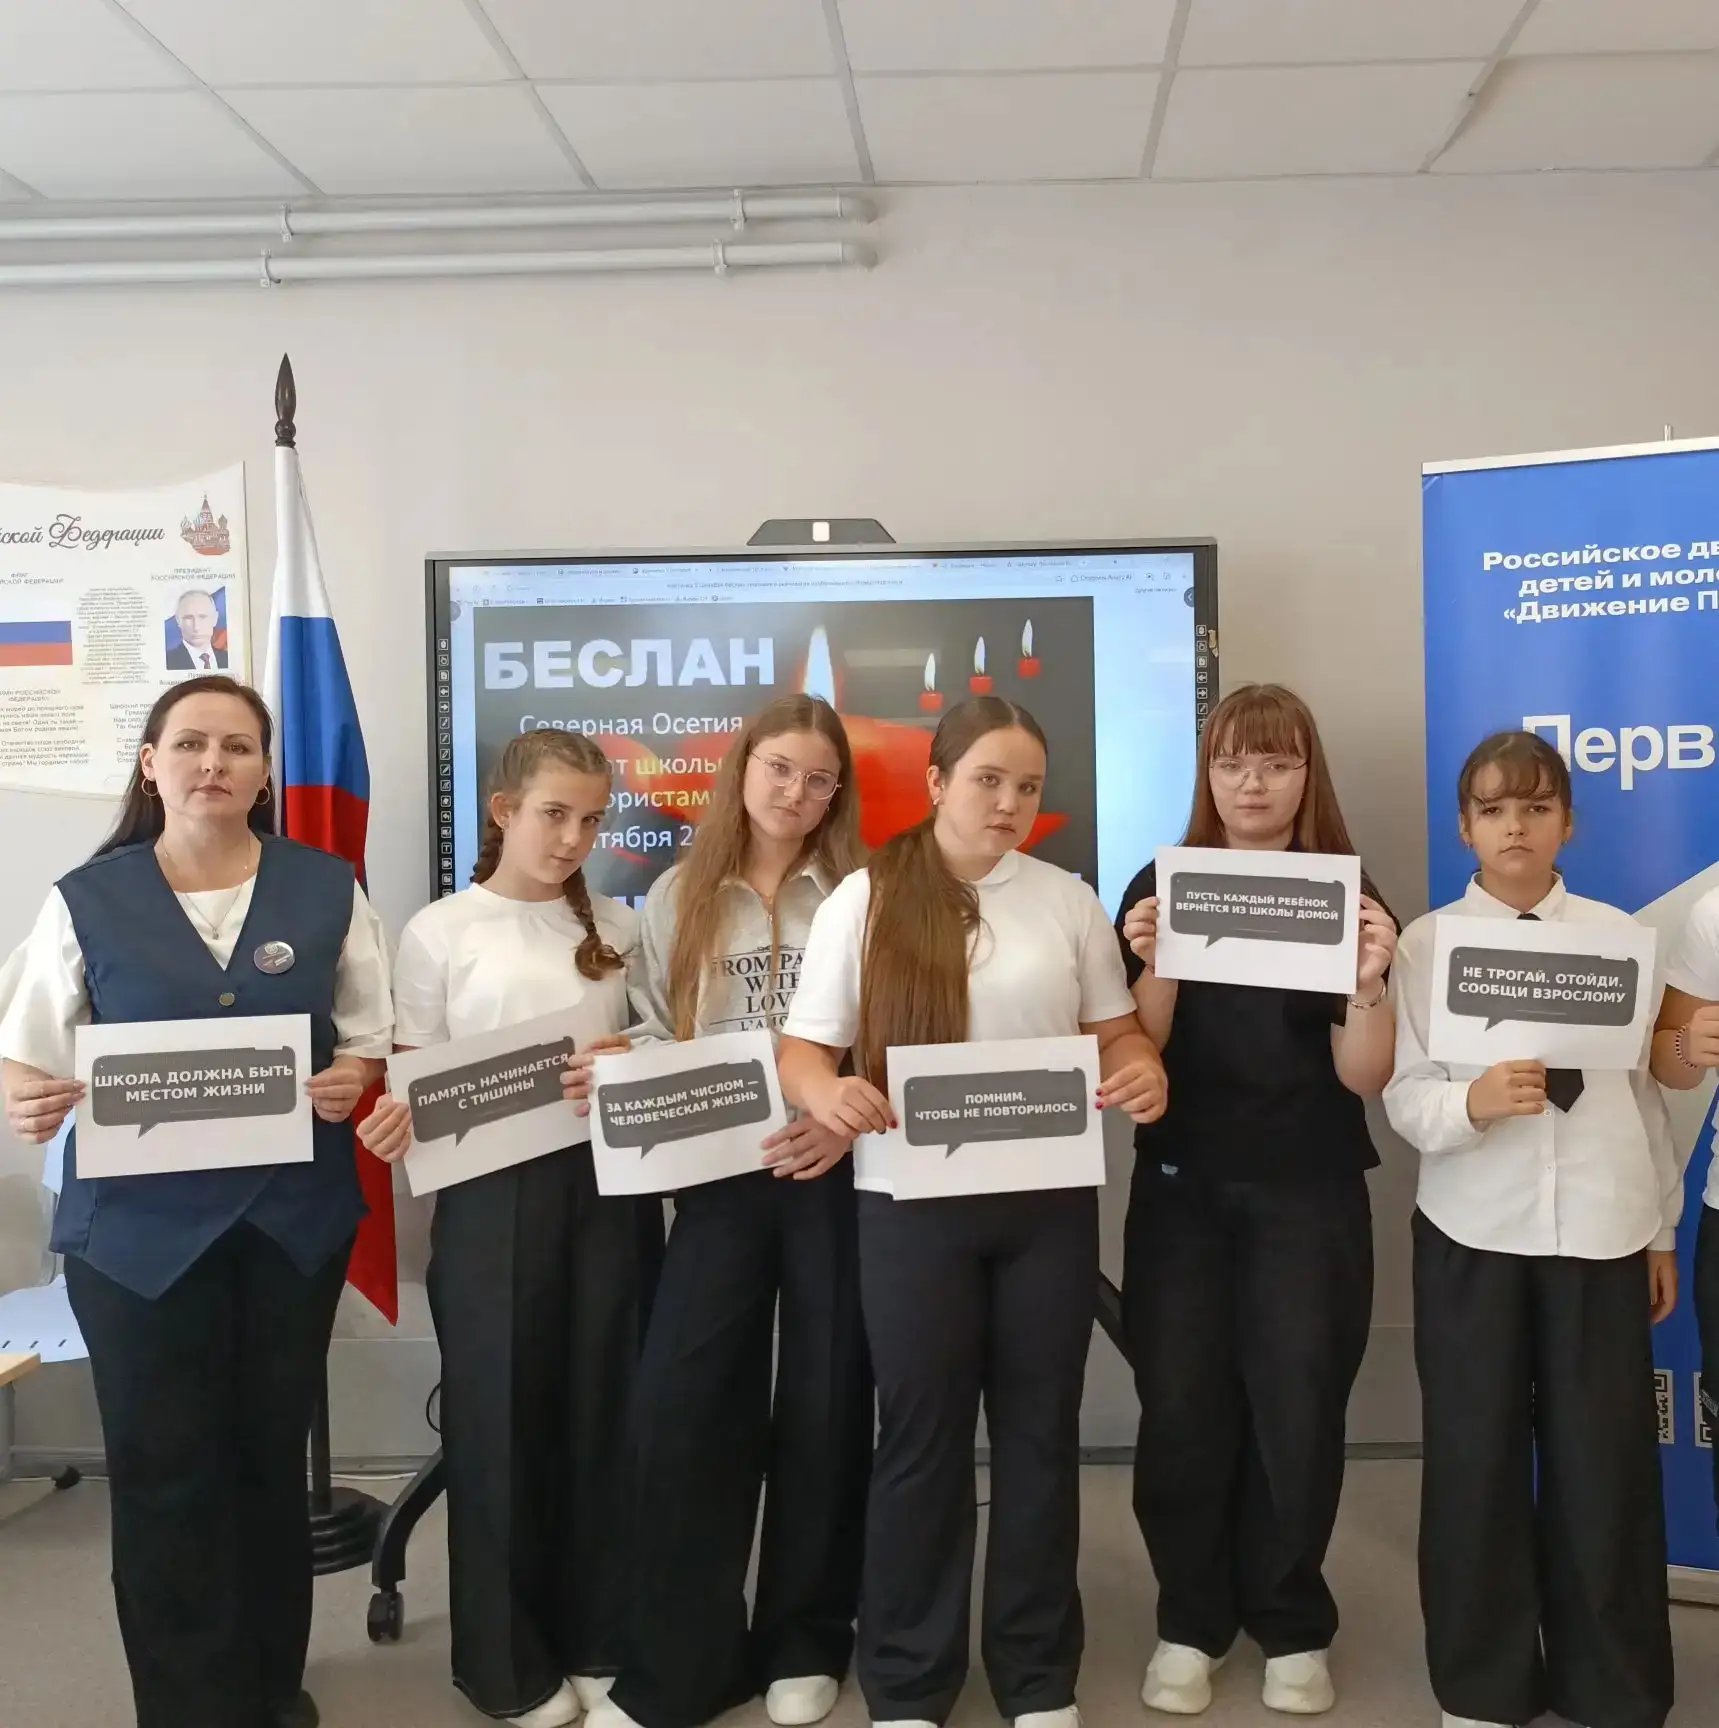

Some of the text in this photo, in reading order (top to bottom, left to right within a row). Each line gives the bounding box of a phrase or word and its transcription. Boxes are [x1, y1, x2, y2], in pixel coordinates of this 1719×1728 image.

[49, 514, 165, 550] Федерации
[1483, 544, 1681, 571] Российское
[1519, 569, 1719, 597] детей и мол
[1503, 597, 1690, 624] «Движение
[484, 637, 775, 690] БЕСЛАН
[652, 712, 743, 735] Осетия
[1522, 714, 1716, 791] Перв
[1176, 901, 1339, 921] ВЕРНЁТСЯ ИЗ ШКОЛЫ ДОМОЙ
[1187, 891, 1329, 908] ПУСТЬ КАЖДЫЙ РЕБЁНОК
[1463, 966, 1623, 989] НЕ ТРОГАЙ. ОТОЙДИ.
[1459, 982, 1626, 1004] СООБЩИ ВЗРОСЛОМУ
[95, 1065, 294, 1088] ШКОЛА ДОЛЖНА БЫТЬ
[417, 1053, 570, 1107] ПАМЯТЬ НАЧИНАЕТСЯ
[125, 1083, 265, 1102] МЕСТОМ ЖИЗНИ
[458, 1077, 535, 1110] С ТИШИНЫ
[606, 1101, 622, 1113] ЗА
[625, 1091, 688, 1112] КАЖДЫМ
[690, 1079, 744, 1098] ЧИСЛОМ
[610, 1092, 758, 1127] ЧЕЛОВЕЧЕСКАЯ ЖИЗНЬ
[915, 1102, 1078, 1121] ЧТОБЫ НЕ ПОВТОРИЛОСЬ
